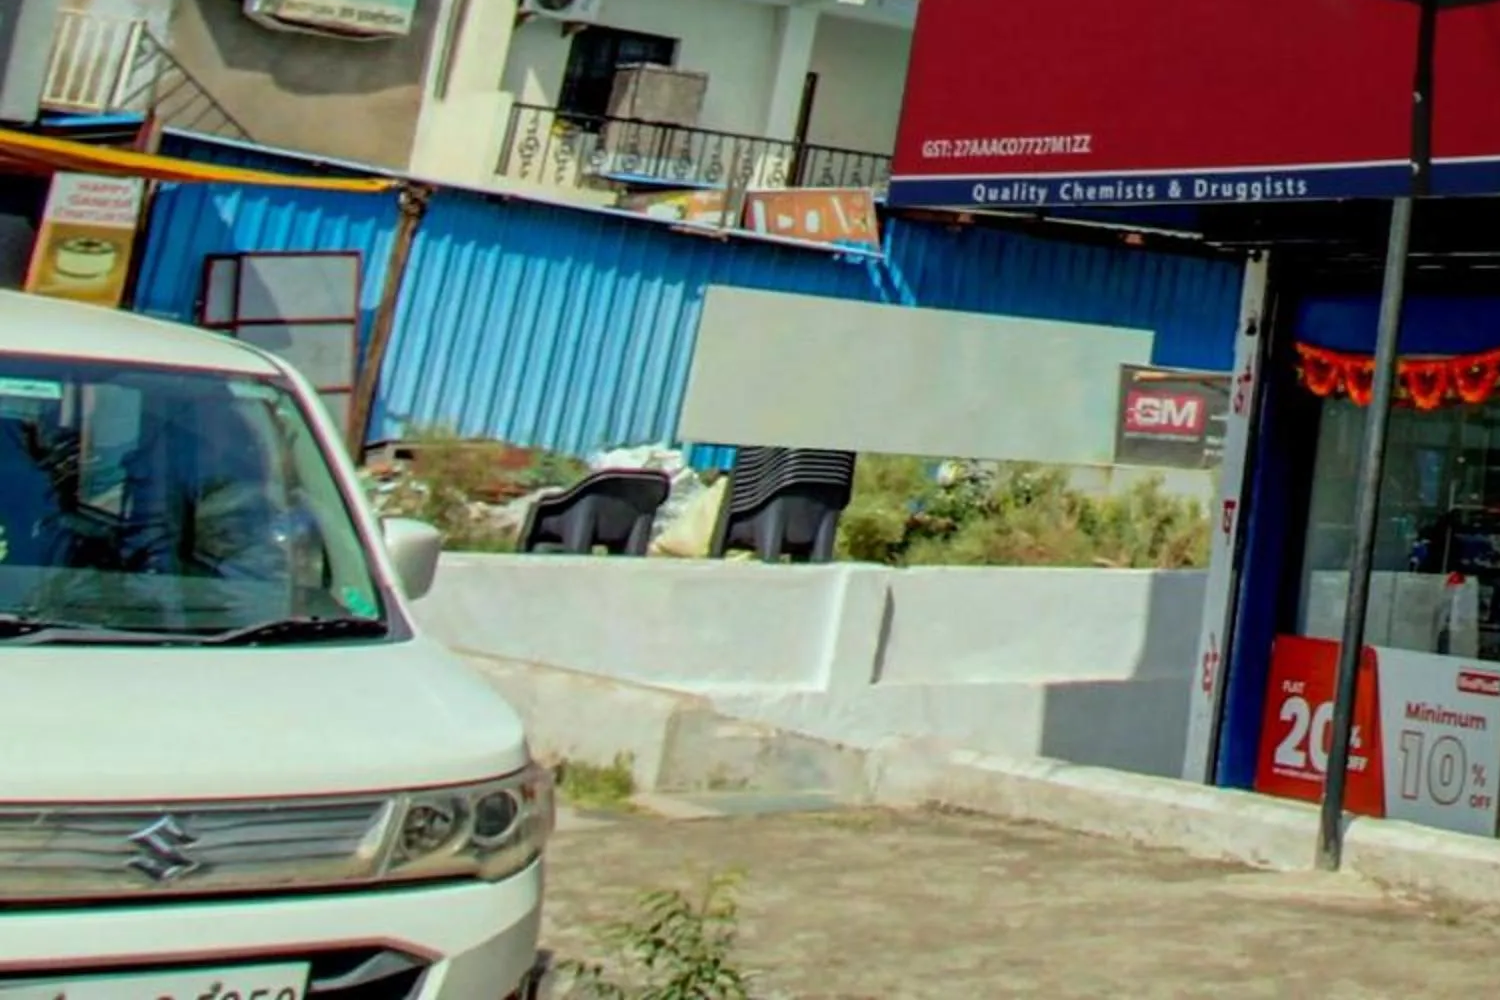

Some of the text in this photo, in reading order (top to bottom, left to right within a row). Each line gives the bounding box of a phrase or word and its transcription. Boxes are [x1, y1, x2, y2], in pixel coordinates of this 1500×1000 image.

[973, 175, 1308, 205] Quality Chemists & Druggists
[1405, 701, 1487, 730] Minimum
[1469, 794, 1492, 809] OFF
